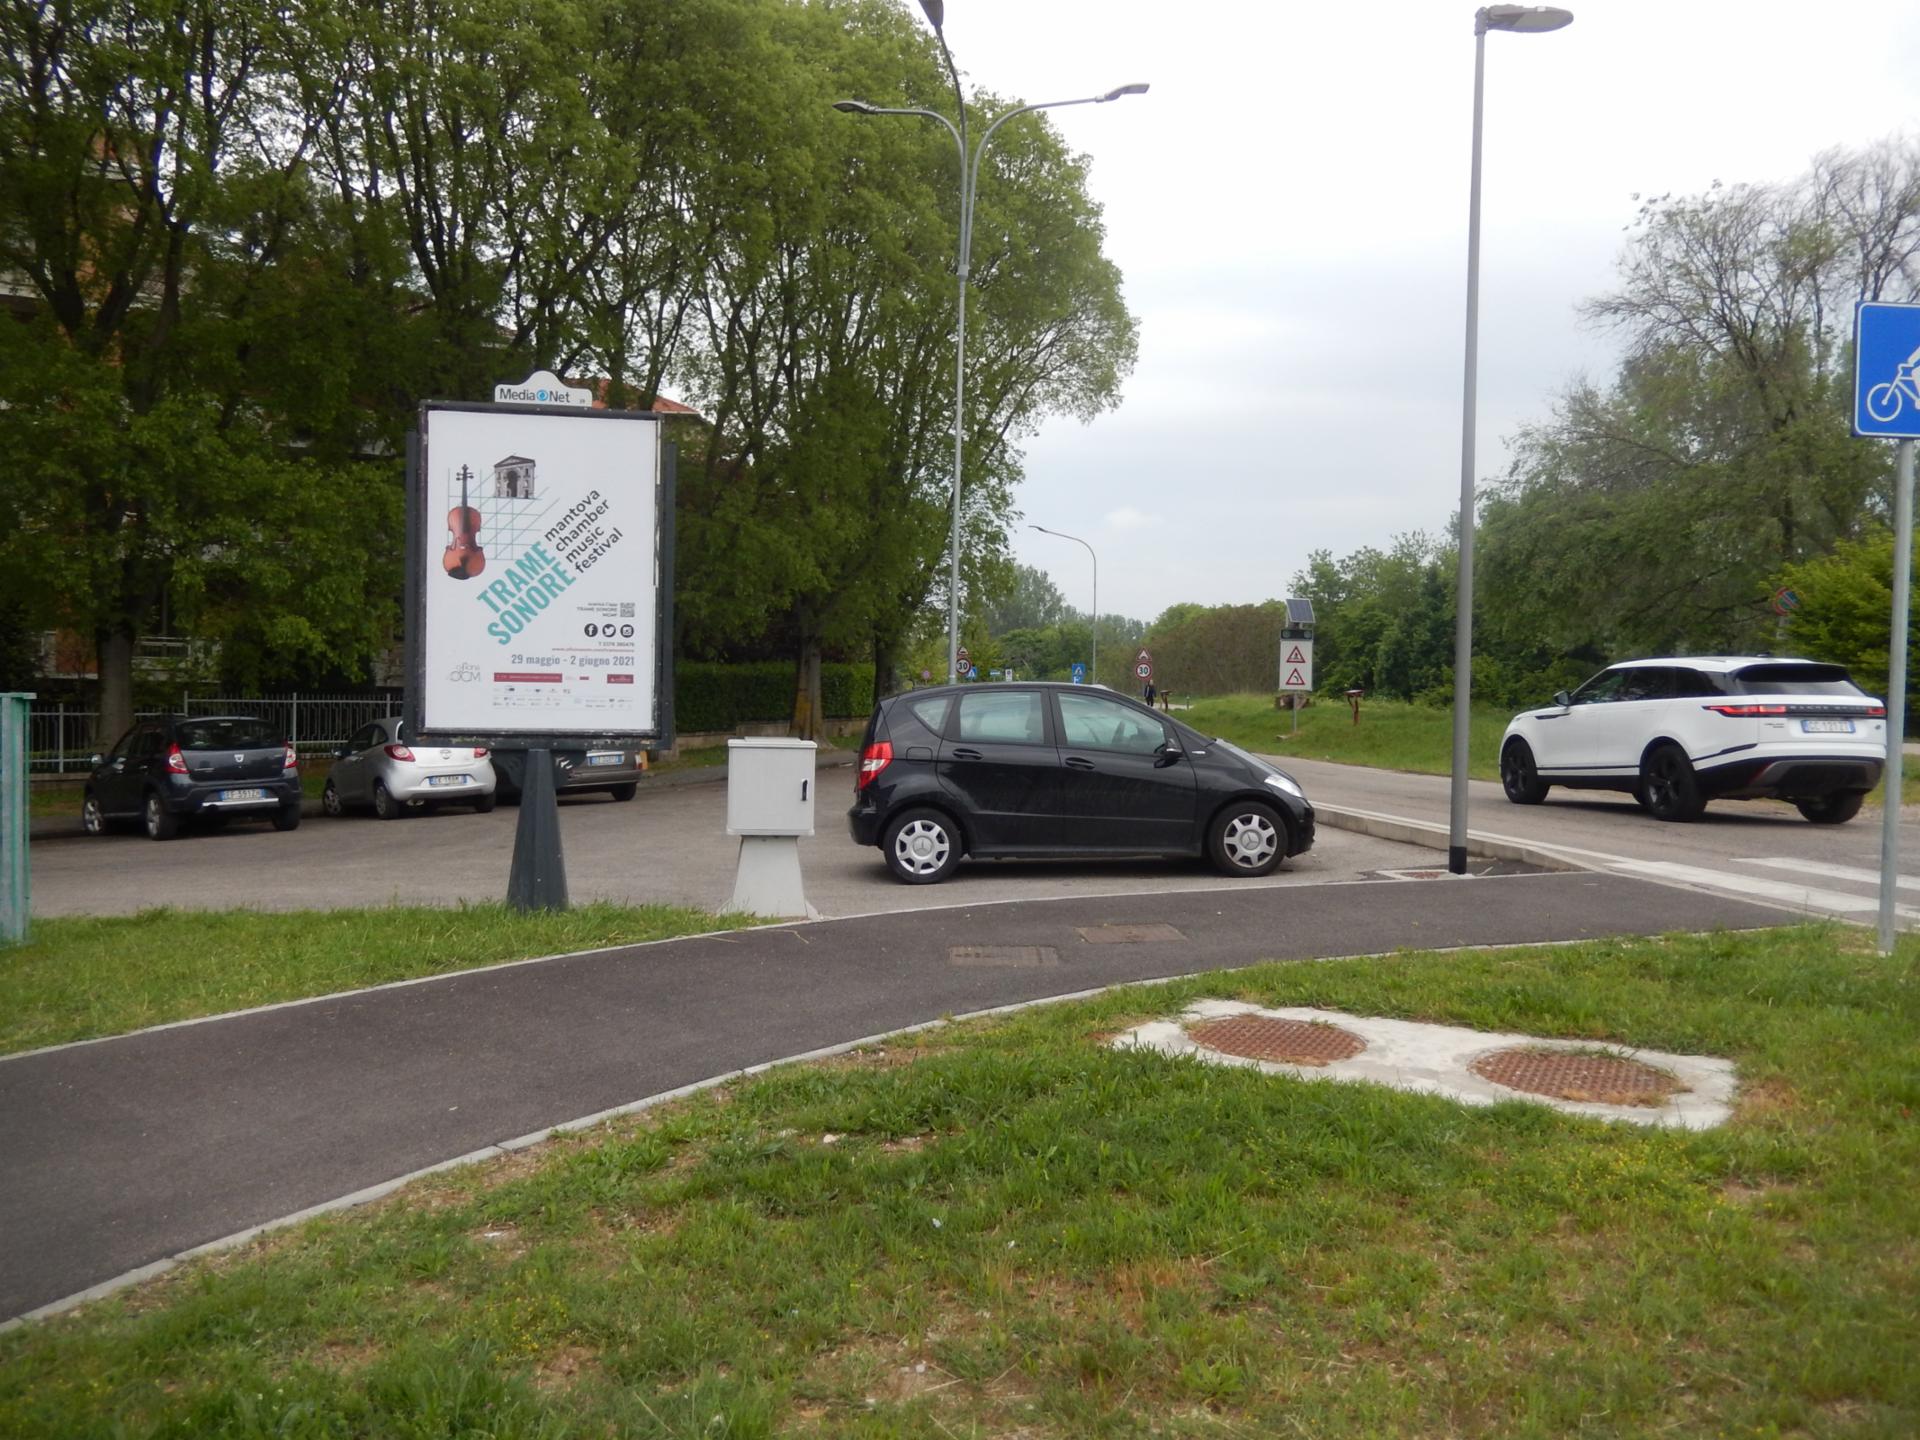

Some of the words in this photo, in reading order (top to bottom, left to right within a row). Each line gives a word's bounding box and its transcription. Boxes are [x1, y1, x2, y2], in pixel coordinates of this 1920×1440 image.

[543, 489, 601, 542] mantova
[555, 499, 610, 552] chamber
[565, 526, 605, 564] music
[575, 527, 624, 574] festival
[476, 541, 556, 614] TRAME
[487, 561, 577, 645] SONORE
[511, 654, 523, 664] 29
[526, 655, 561, 667] maggio
[570, 656, 577, 666] 2
[579, 656, 610, 668] giugno
[612, 656, 635, 667] 2021
